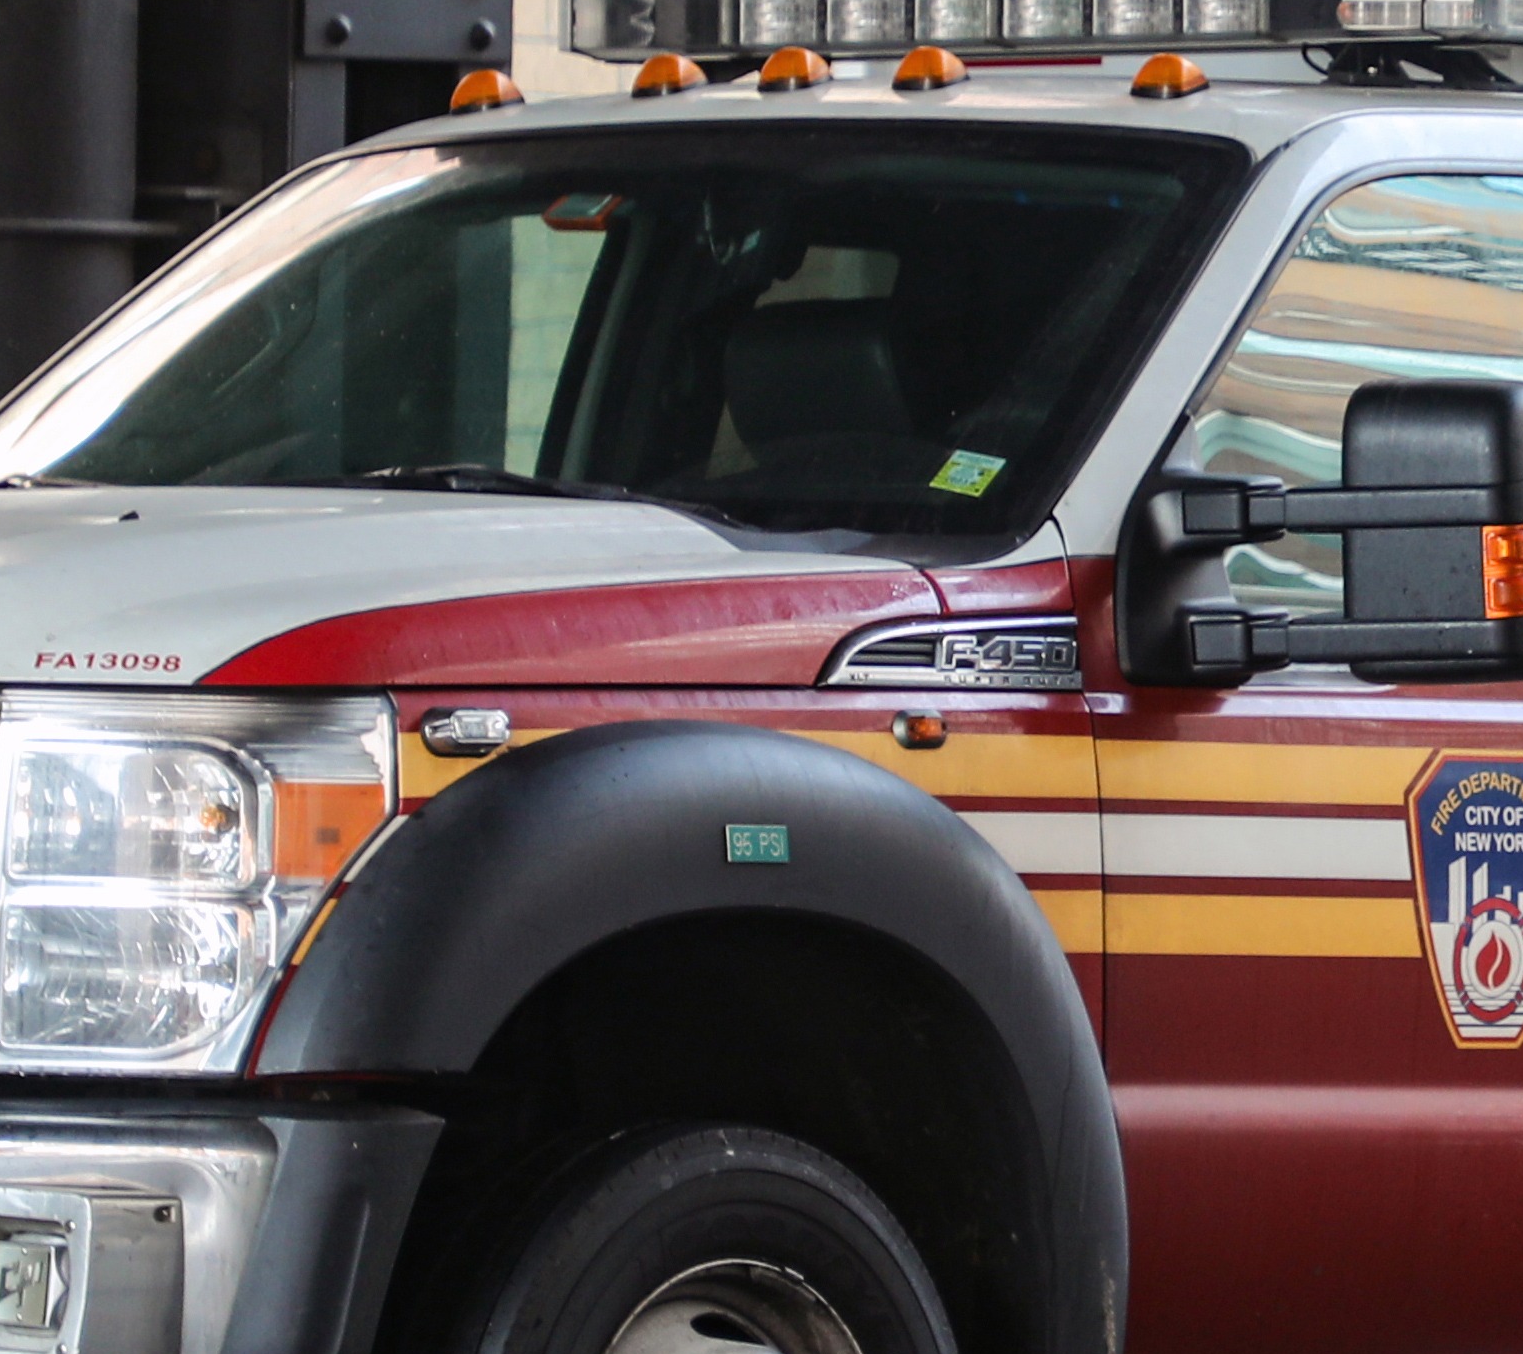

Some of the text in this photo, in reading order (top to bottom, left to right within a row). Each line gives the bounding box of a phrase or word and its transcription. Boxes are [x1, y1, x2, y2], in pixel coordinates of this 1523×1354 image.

[34, 652, 181, 672] FA13098
[940, 634, 1077, 673] F-450
[1430, 788, 1462, 836] FIRE
[1465, 805, 1500, 825] CITY
[759, 831, 784, 856] PSI
[1454, 832, 1492, 852] NEW
